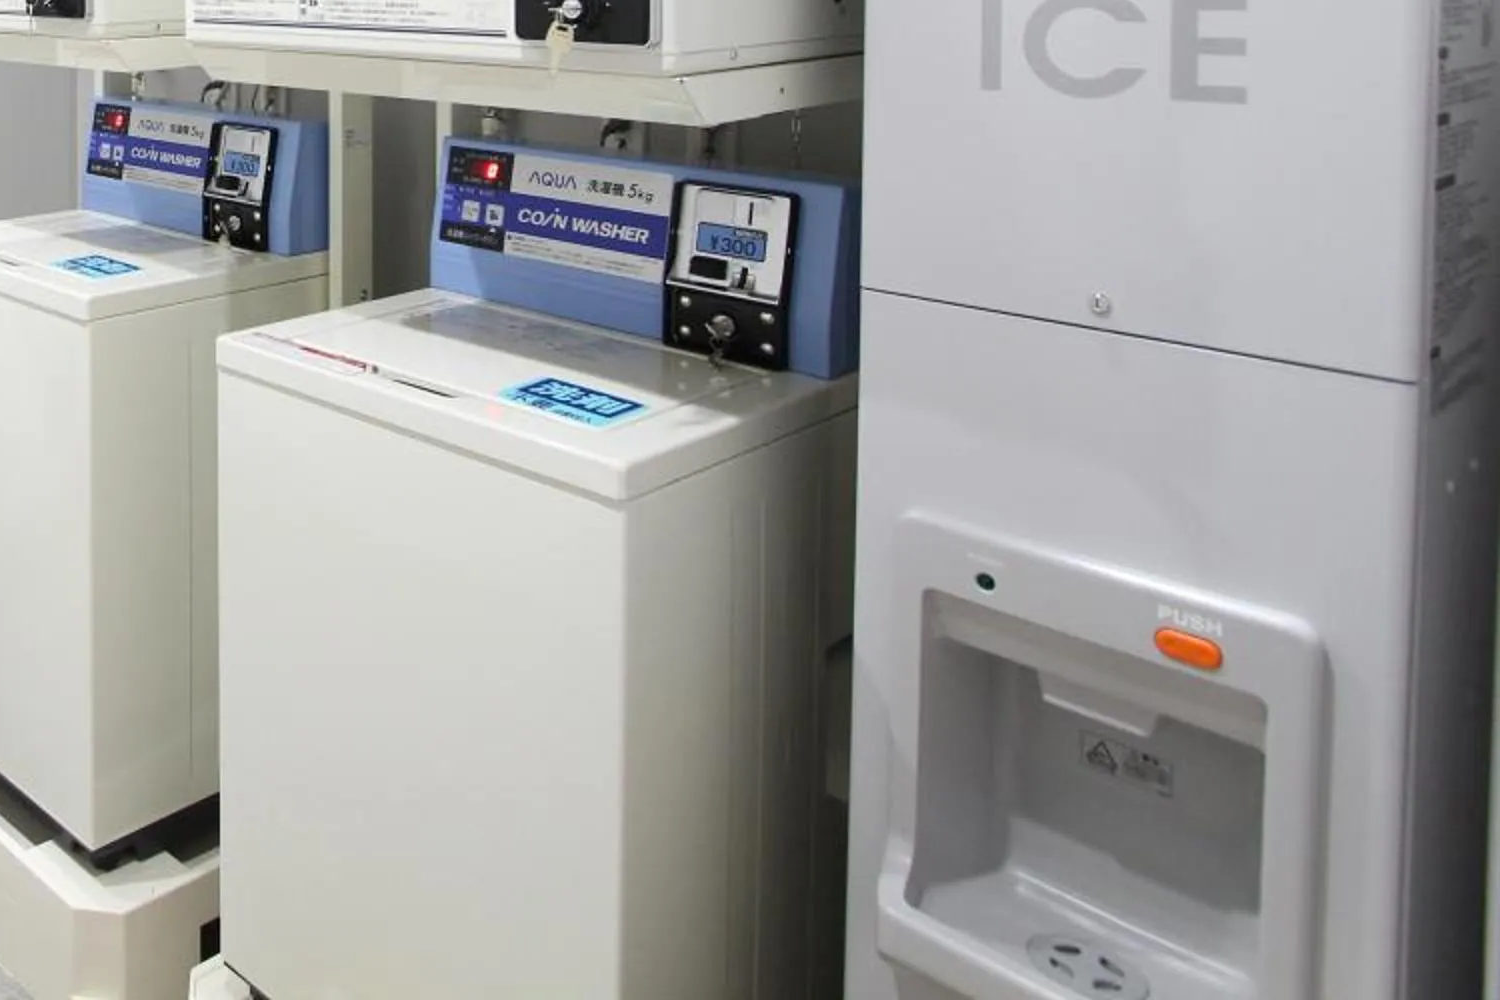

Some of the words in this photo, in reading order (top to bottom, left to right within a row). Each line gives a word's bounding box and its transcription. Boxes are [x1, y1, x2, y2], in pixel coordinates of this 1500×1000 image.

[528, 171, 578, 191] AQUA
[586, 179, 626, 197] 洗濯機
[626, 183, 655, 205] 5kg
[571, 216, 650, 245] WASHER
[710, 234, 757, 257] ¥300
[1157, 602, 1223, 638] PUSH
